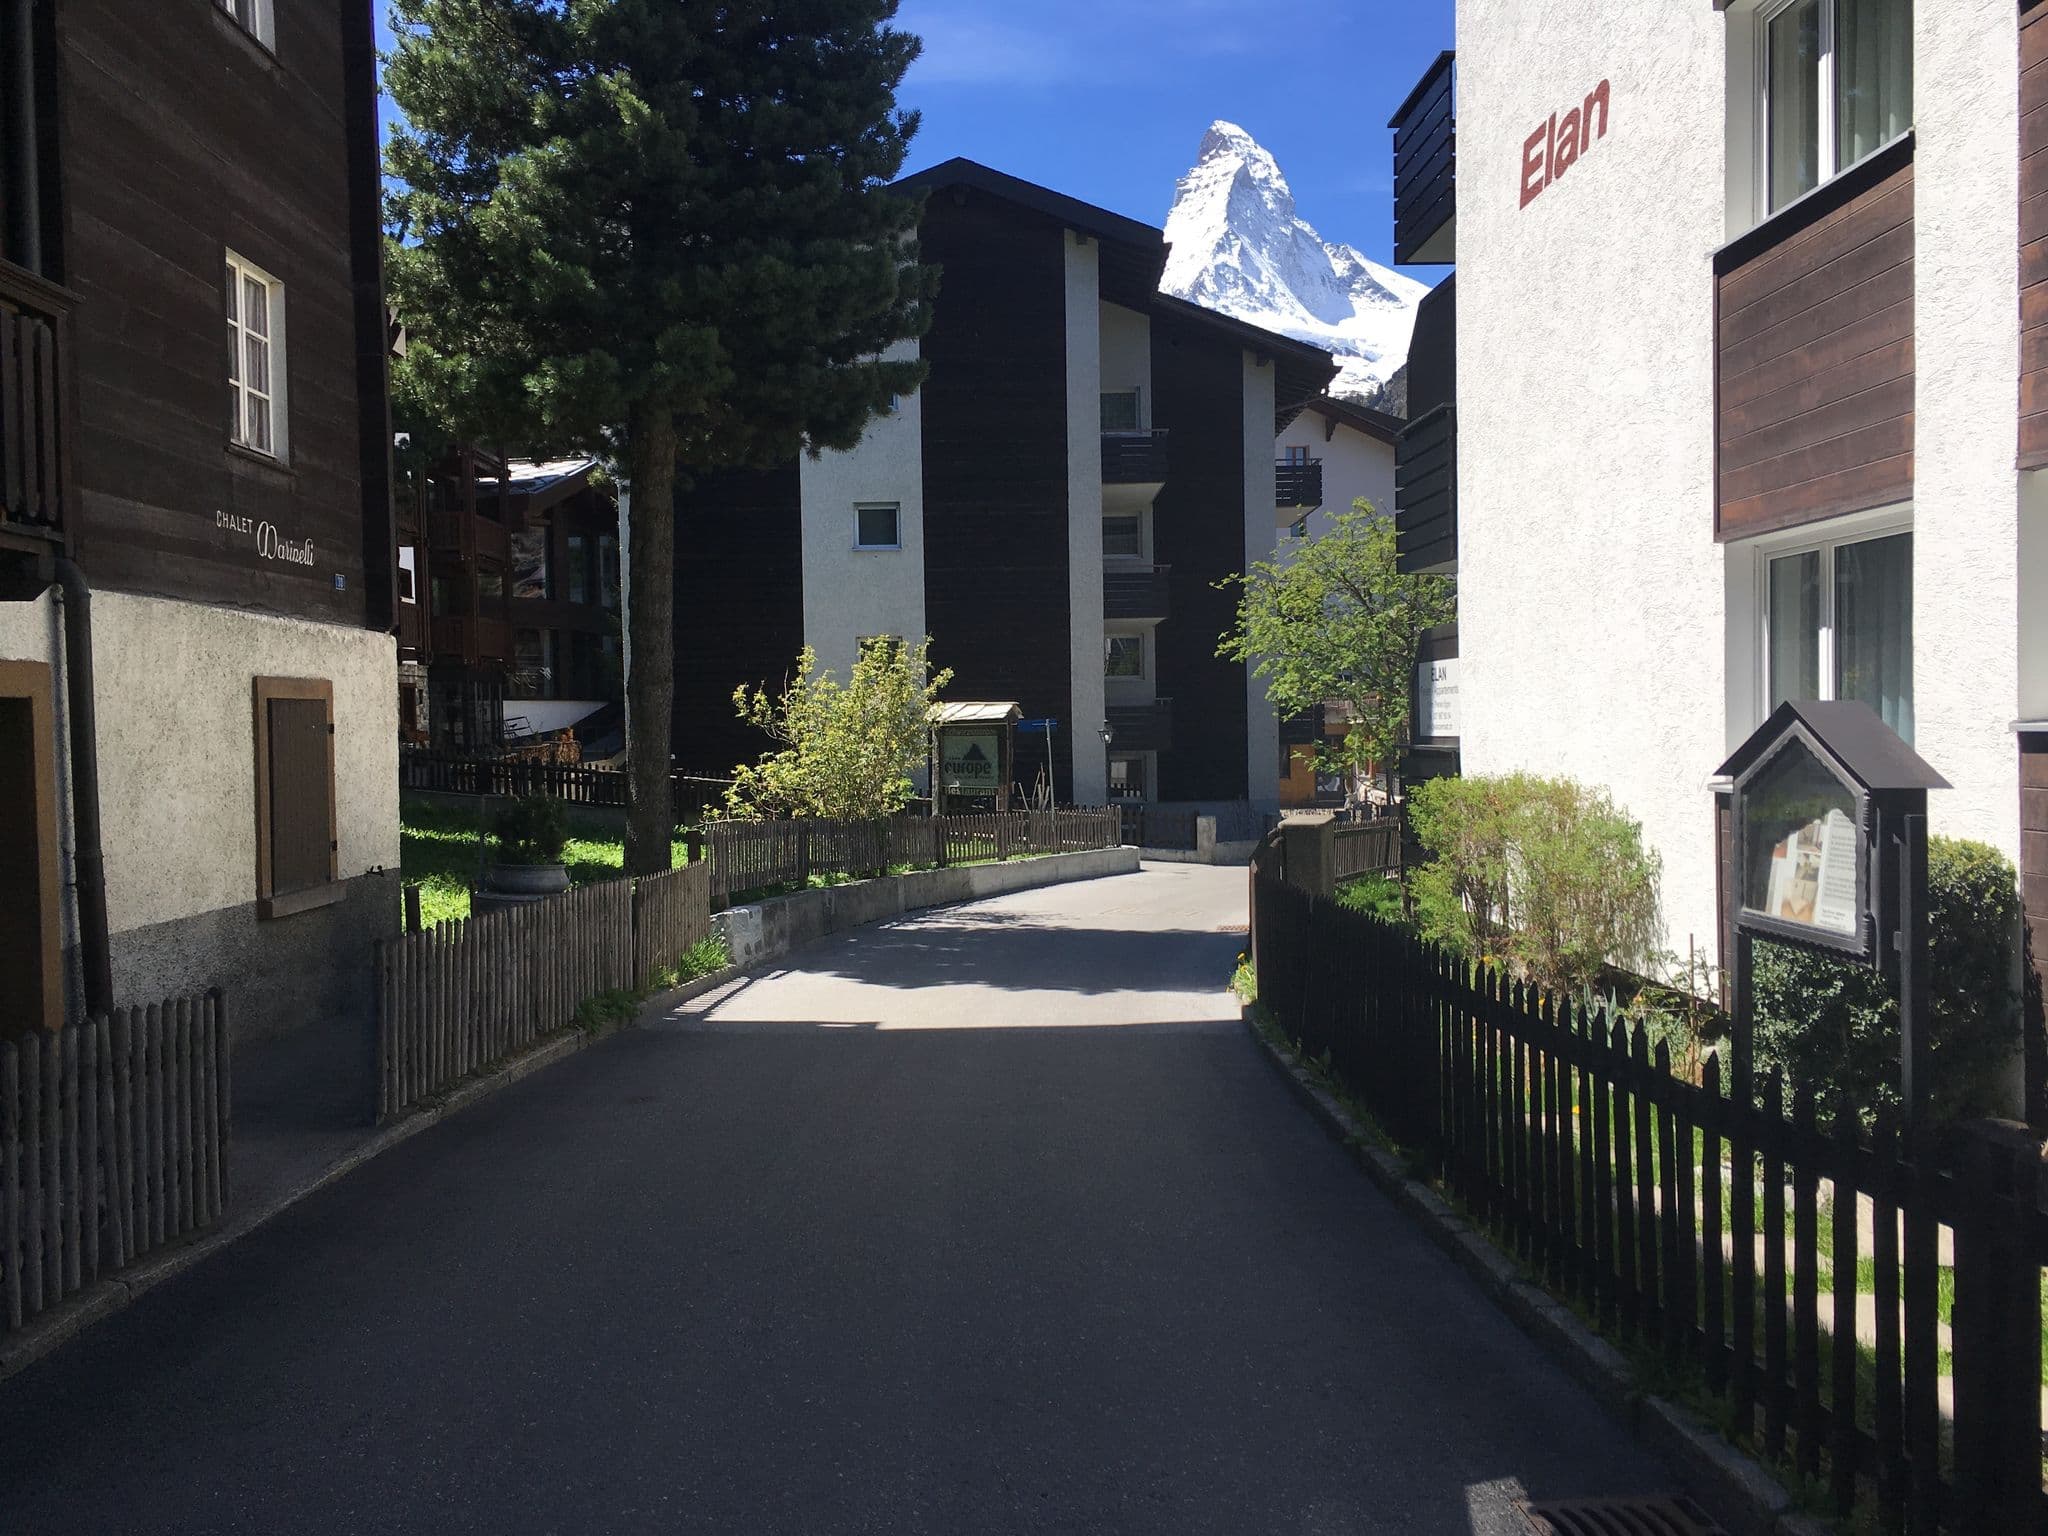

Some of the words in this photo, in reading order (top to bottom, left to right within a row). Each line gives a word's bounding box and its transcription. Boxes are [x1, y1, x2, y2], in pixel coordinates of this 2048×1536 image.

[1519, 78, 1611, 211] Elan
[216, 510, 253, 534] CHALET
[1431, 665, 1447, 682] ELAN
[944, 761, 992, 779] europe
